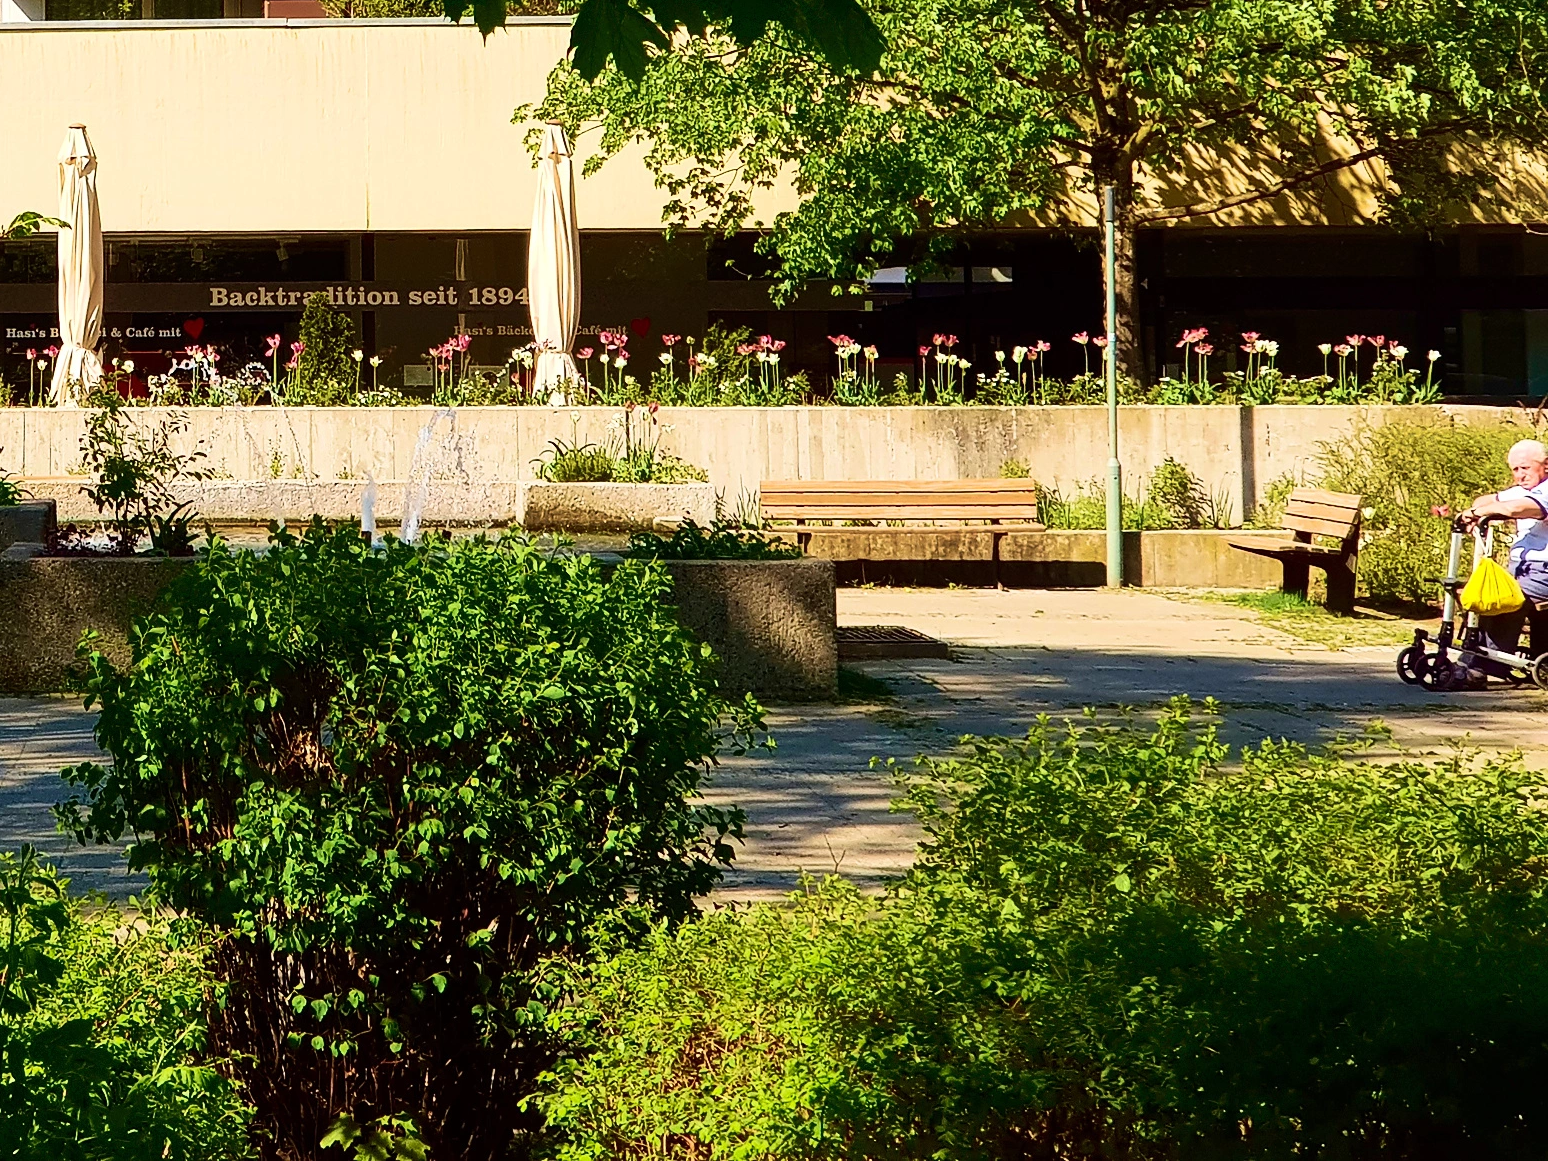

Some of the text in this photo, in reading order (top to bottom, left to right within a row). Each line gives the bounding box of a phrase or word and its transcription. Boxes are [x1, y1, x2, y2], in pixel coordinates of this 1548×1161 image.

[209, 286, 529, 306] Backtradition seit 1894
[110, 327, 122, 338] &
[125, 327, 155, 338] Café
[159, 327, 182, 337] mit
[605, 324, 629, 335] mit
